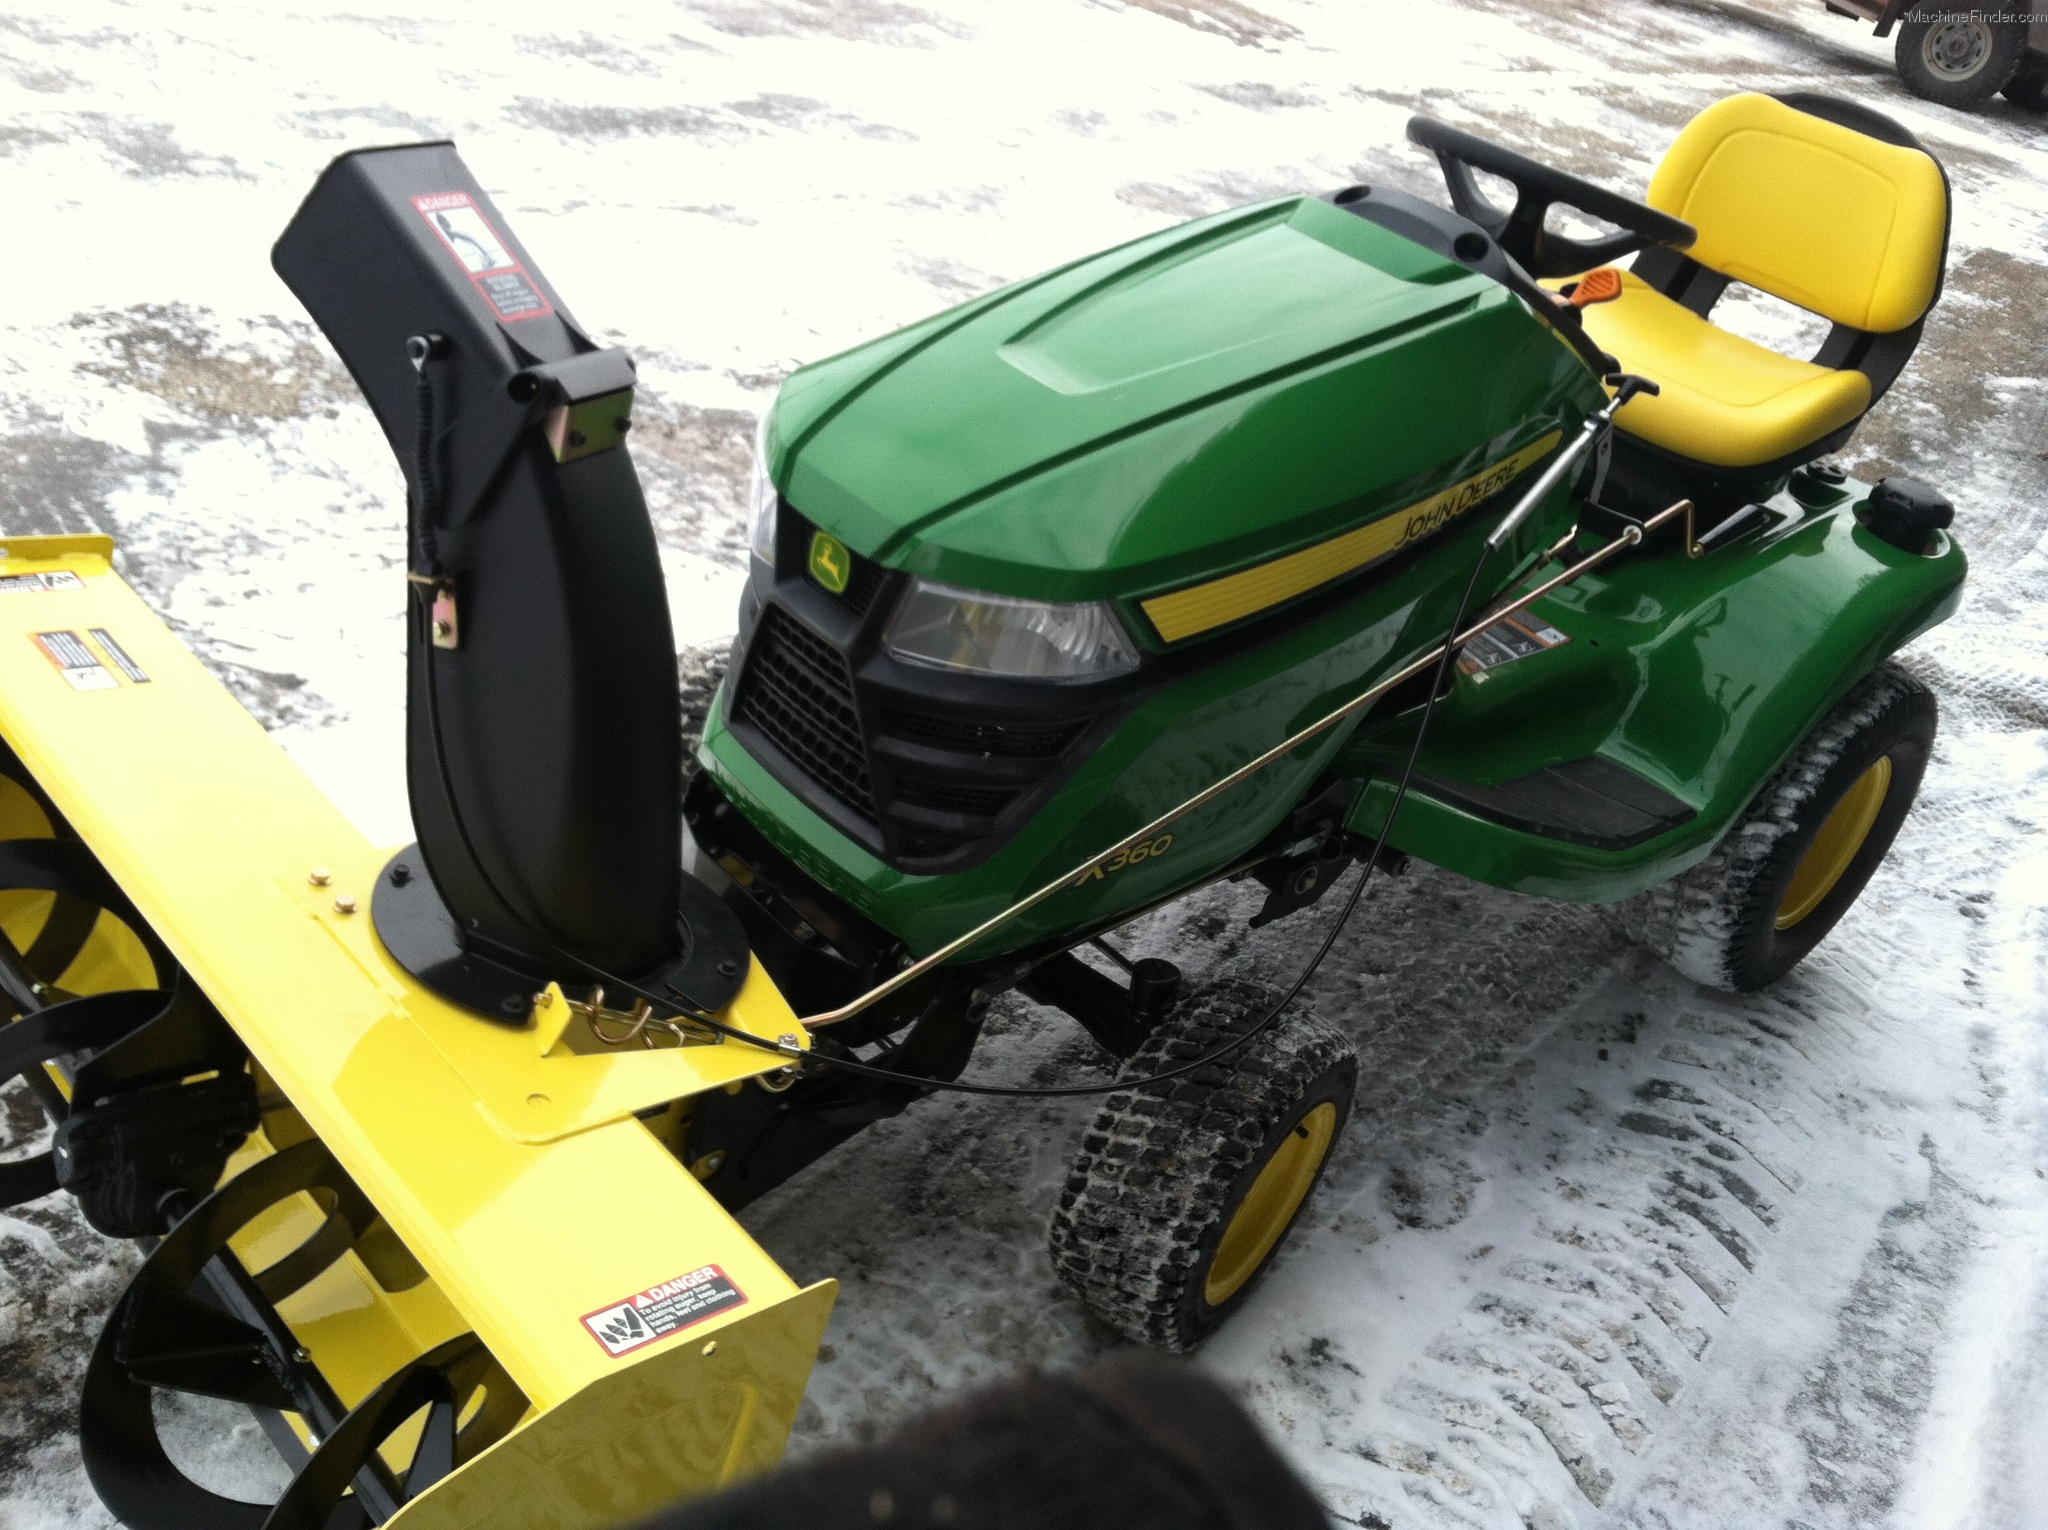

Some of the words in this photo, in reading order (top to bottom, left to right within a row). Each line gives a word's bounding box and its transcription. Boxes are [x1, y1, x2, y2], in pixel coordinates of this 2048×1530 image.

[1394, 497, 1456, 547] JOHN
[1457, 458, 1519, 512] DEERE
[639, 1308, 652, 1316] To
[651, 1298, 674, 1311] avoid
[671, 1290, 694, 1303] injury
[693, 1283, 712, 1293] from
[648, 1266, 718, 1301] DANGER
[690, 1300, 706, 1311] and
[705, 1289, 736, 1304] clothing
